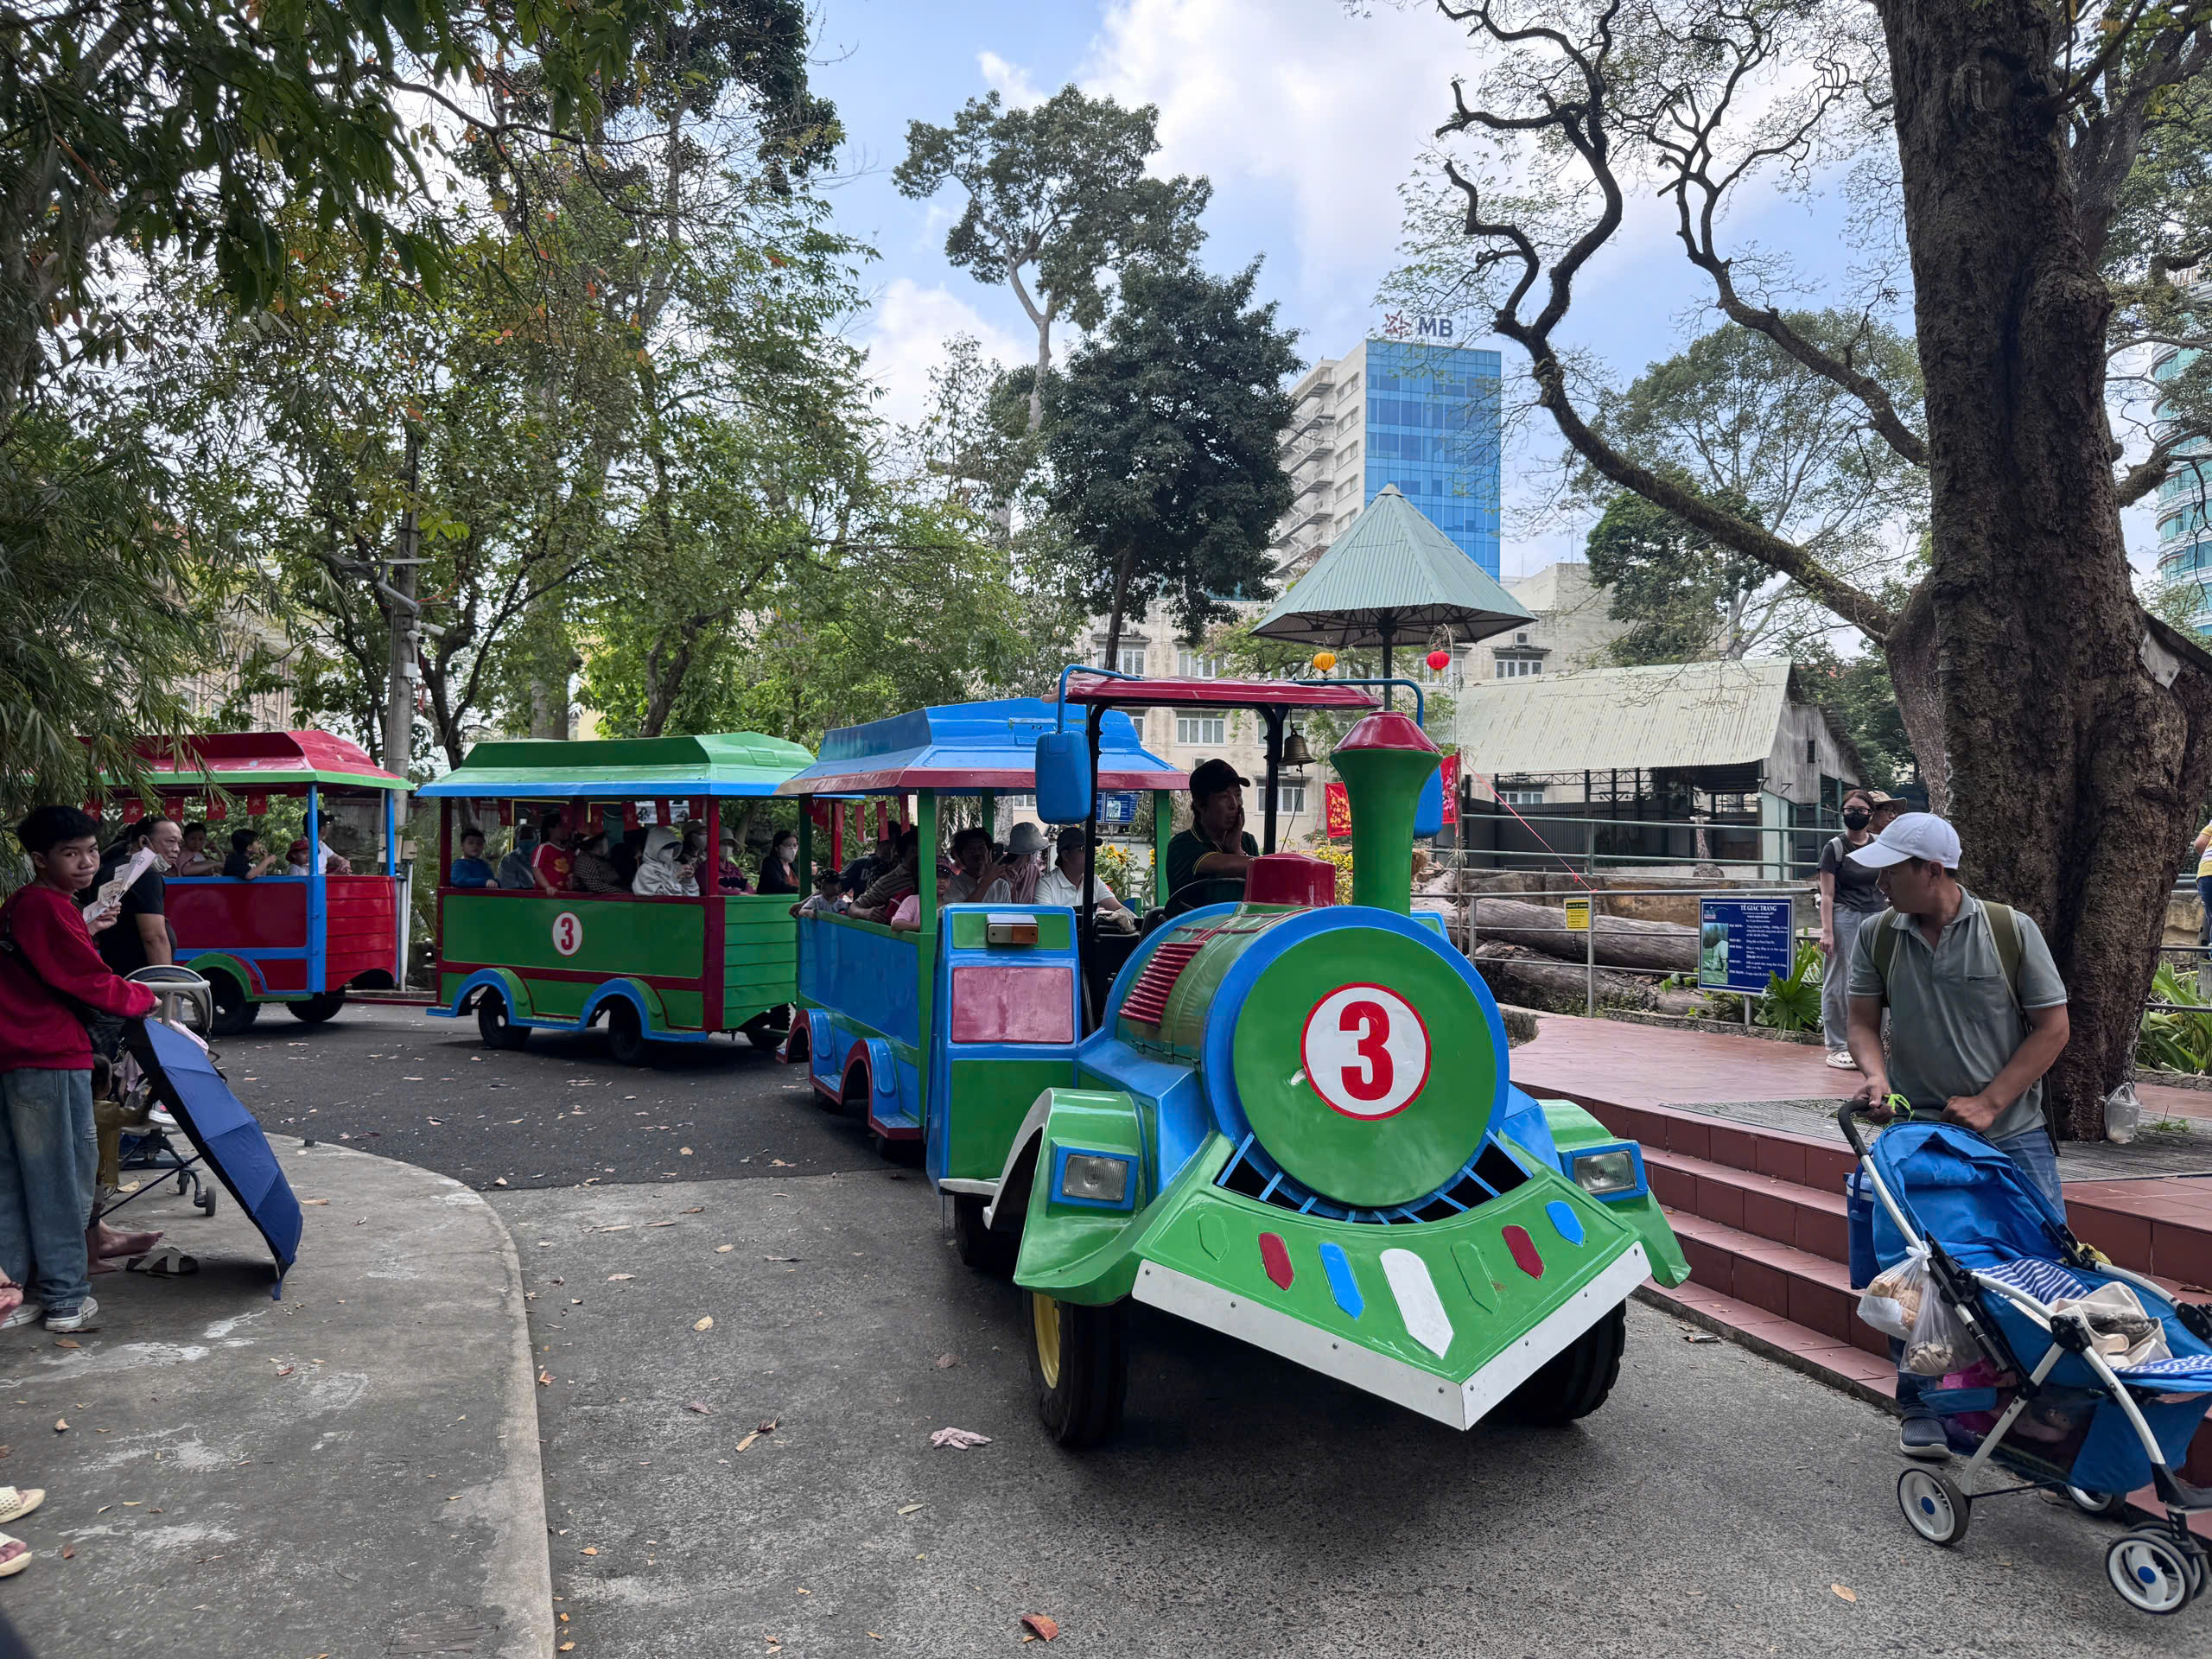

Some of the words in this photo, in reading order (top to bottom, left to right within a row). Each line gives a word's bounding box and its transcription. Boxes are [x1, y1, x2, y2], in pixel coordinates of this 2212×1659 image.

[1418, 316, 1453, 337] MB
[561, 917, 574, 950] 3
[1339, 1001, 1394, 1101] 3
